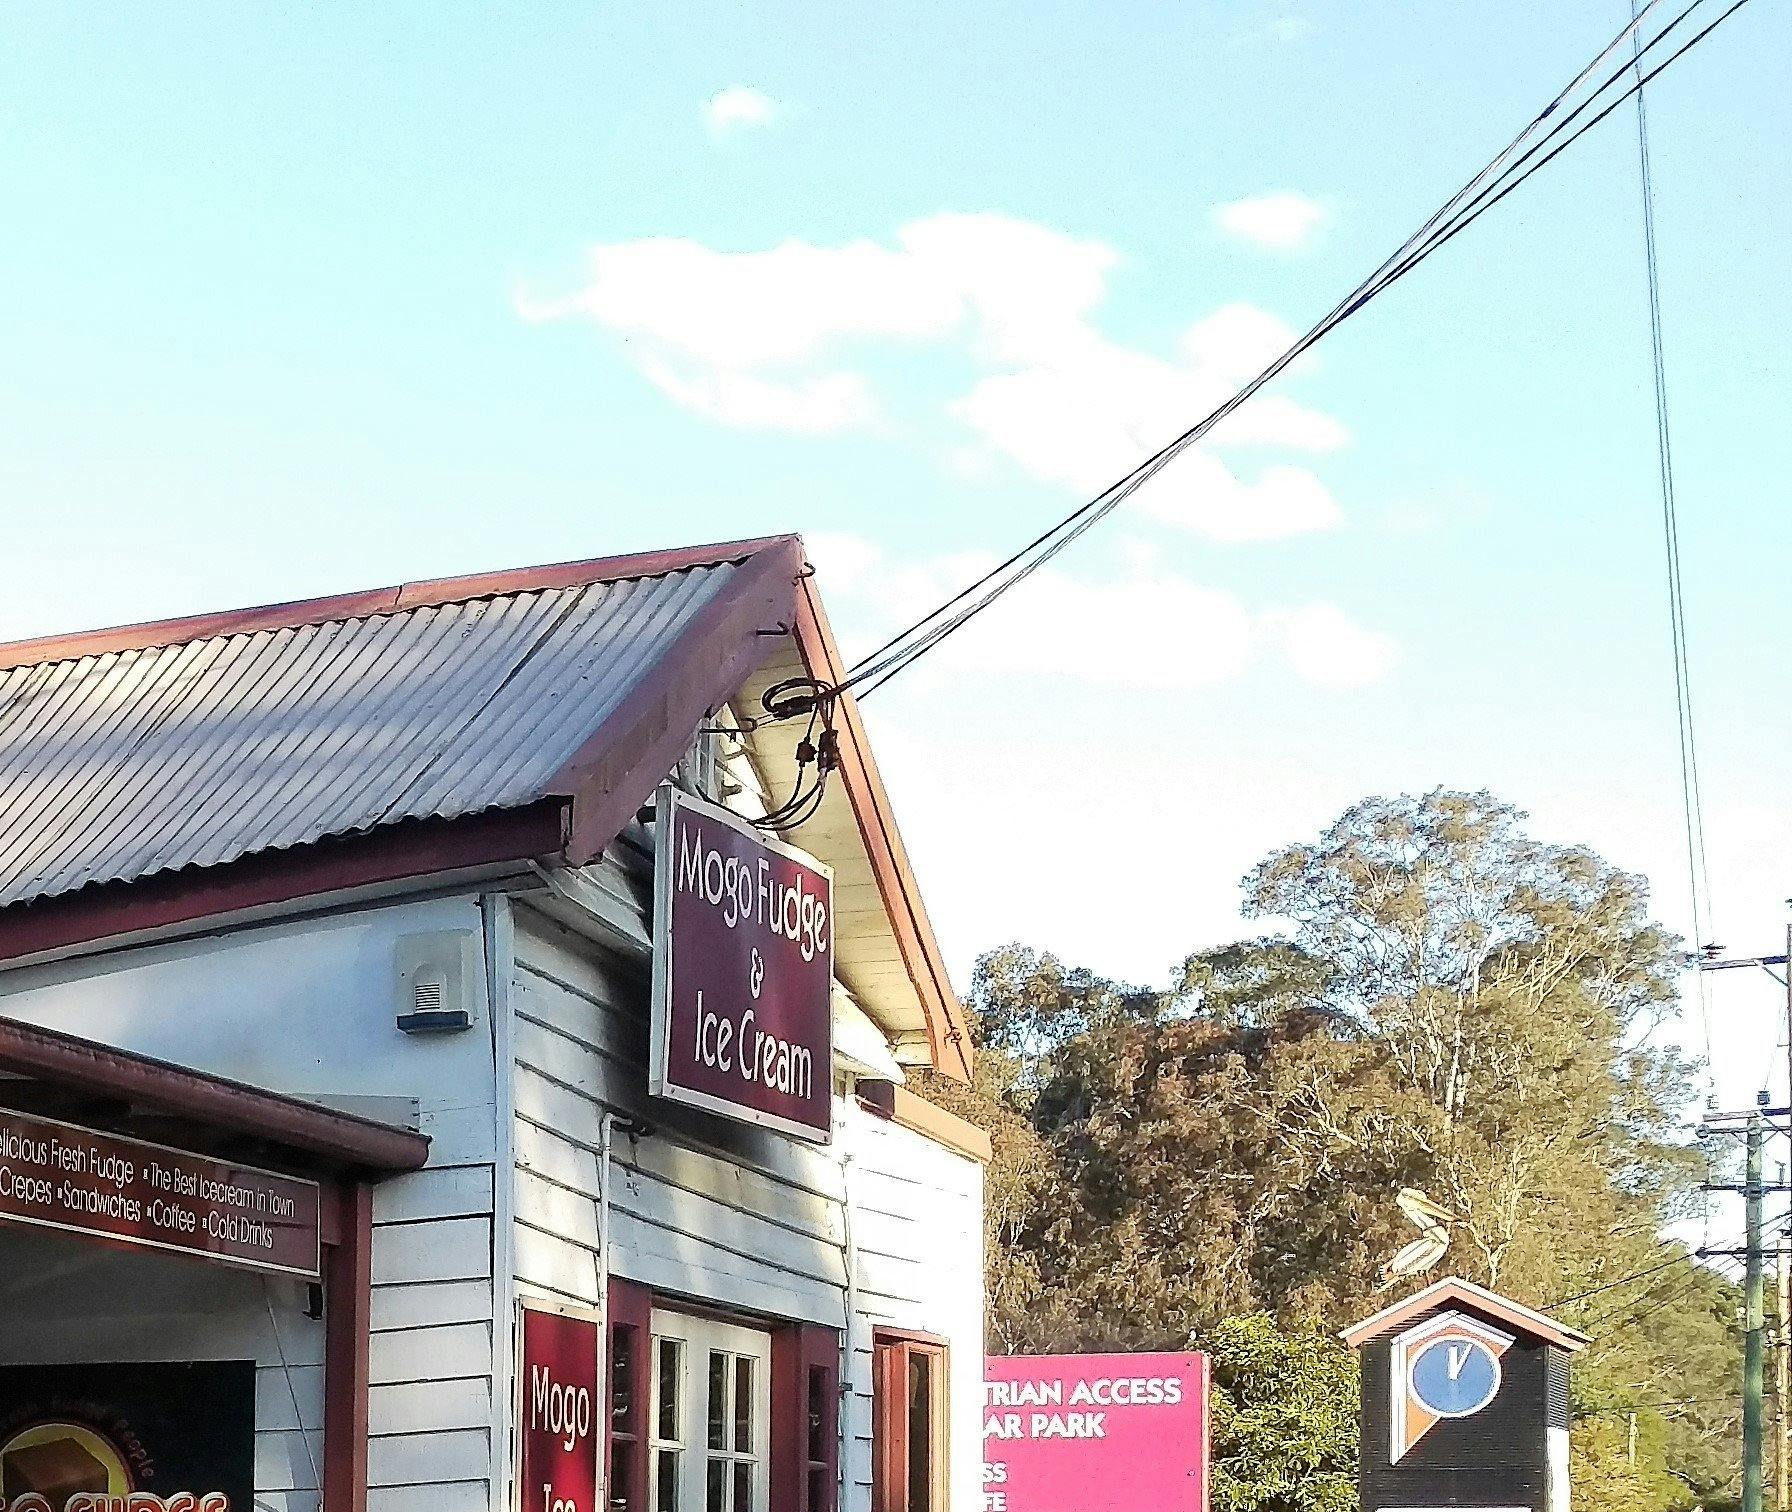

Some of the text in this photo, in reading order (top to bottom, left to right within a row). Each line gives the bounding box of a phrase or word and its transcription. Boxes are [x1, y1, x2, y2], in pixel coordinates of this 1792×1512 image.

[678, 822, 829, 962] Mogo Fudge
[749, 947, 764, 1000] &
[695, 990, 813, 1100] Ice Cream
[50, 1138, 86, 1174] Fresh
[89, 1147, 135, 1185] Fudge
[150, 1162, 172, 1191] The
[173, 1165, 198, 1197] Best
[199, 1172, 255, 1210] Icecream
[256, 1186, 267, 1211] in
[268, 1189, 295, 1219] Town
[62, 1180, 141, 1223] Sandwiches
[152, 1199, 196, 1233] Coffee
[208, 1209, 238, 1242] Cold
[239, 1217, 273, 1250] Drinks
[531, 1364, 590, 1452] Mogo
[983, 1412, 1107, 1439] AR PARK
[1069, 1377, 1183, 1406] ACCESS
